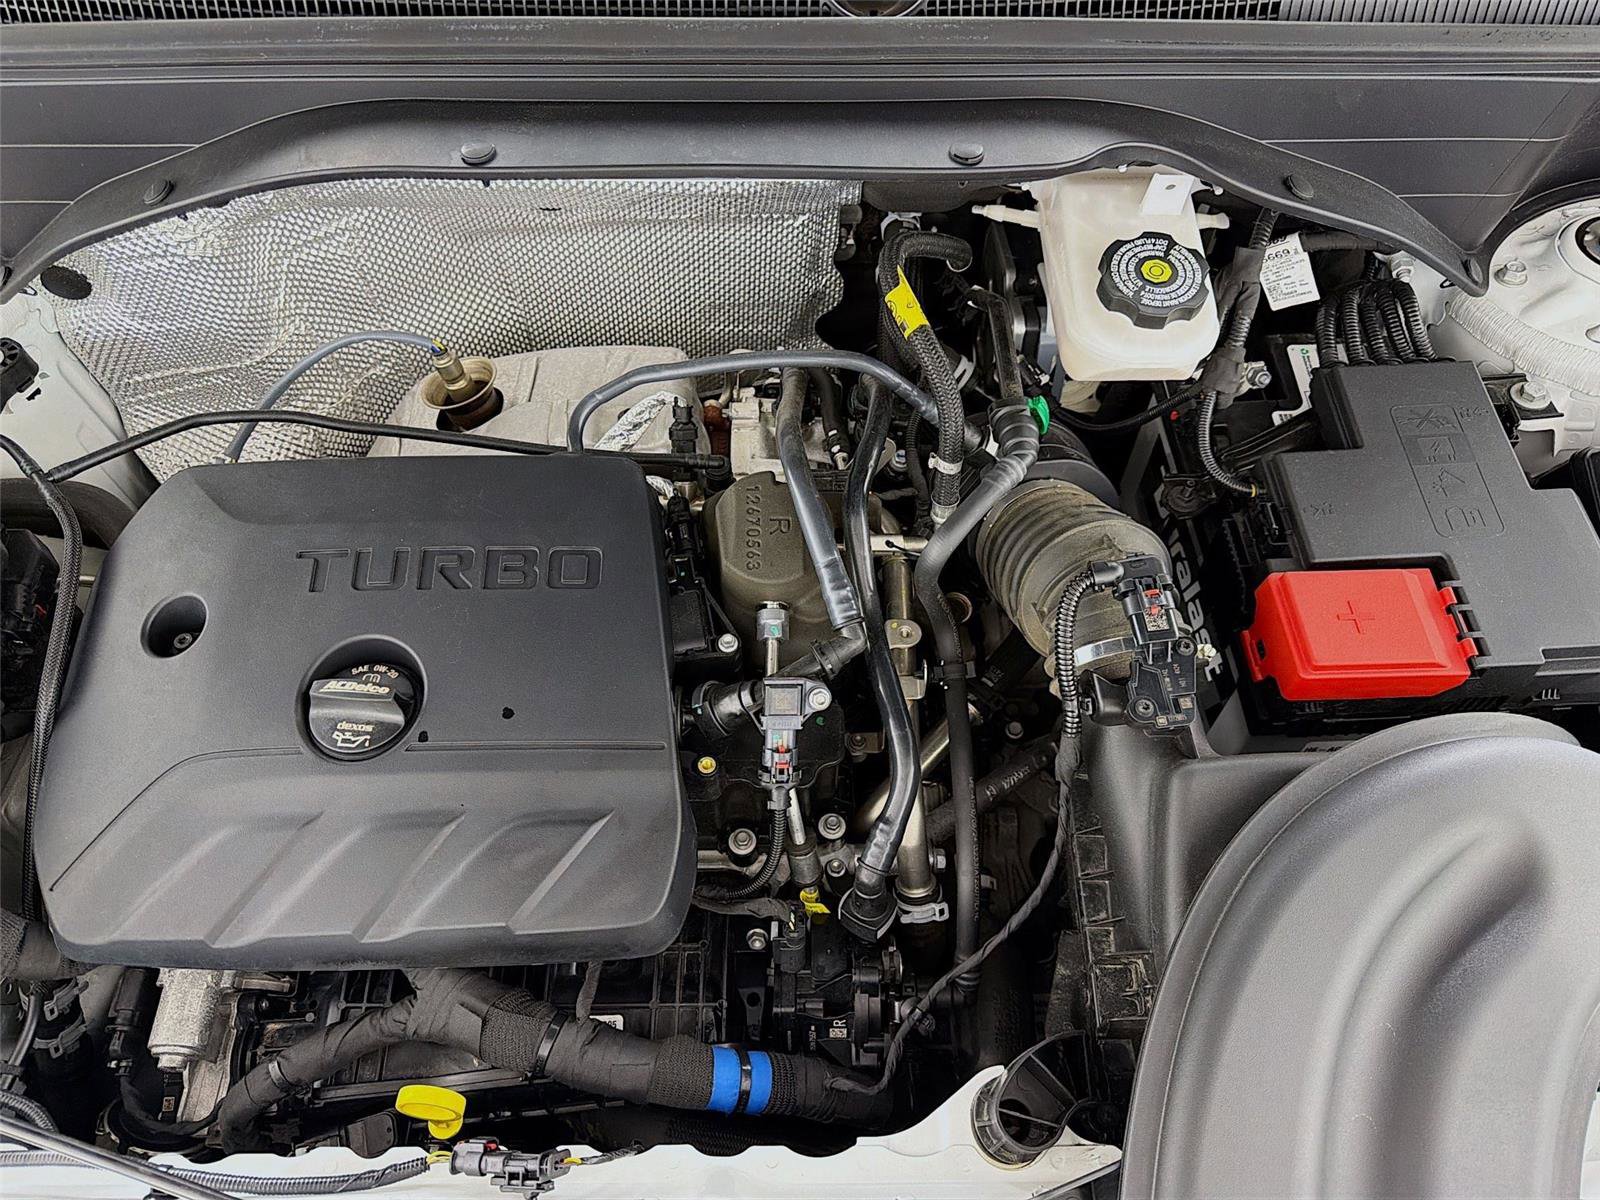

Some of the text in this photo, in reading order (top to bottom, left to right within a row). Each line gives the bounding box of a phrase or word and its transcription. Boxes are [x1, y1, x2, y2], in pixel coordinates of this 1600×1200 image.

[745, 485, 761, 571] 12670563
[769, 517, 791, 535] R
[296, 545, 603, 592] TURBO
[351, 664, 399, 679] SAE 0W-20
[322, 680, 390, 694] ACDelco
[336, 721, 375, 732] dexos
[833, 1019, 847, 1027] R
